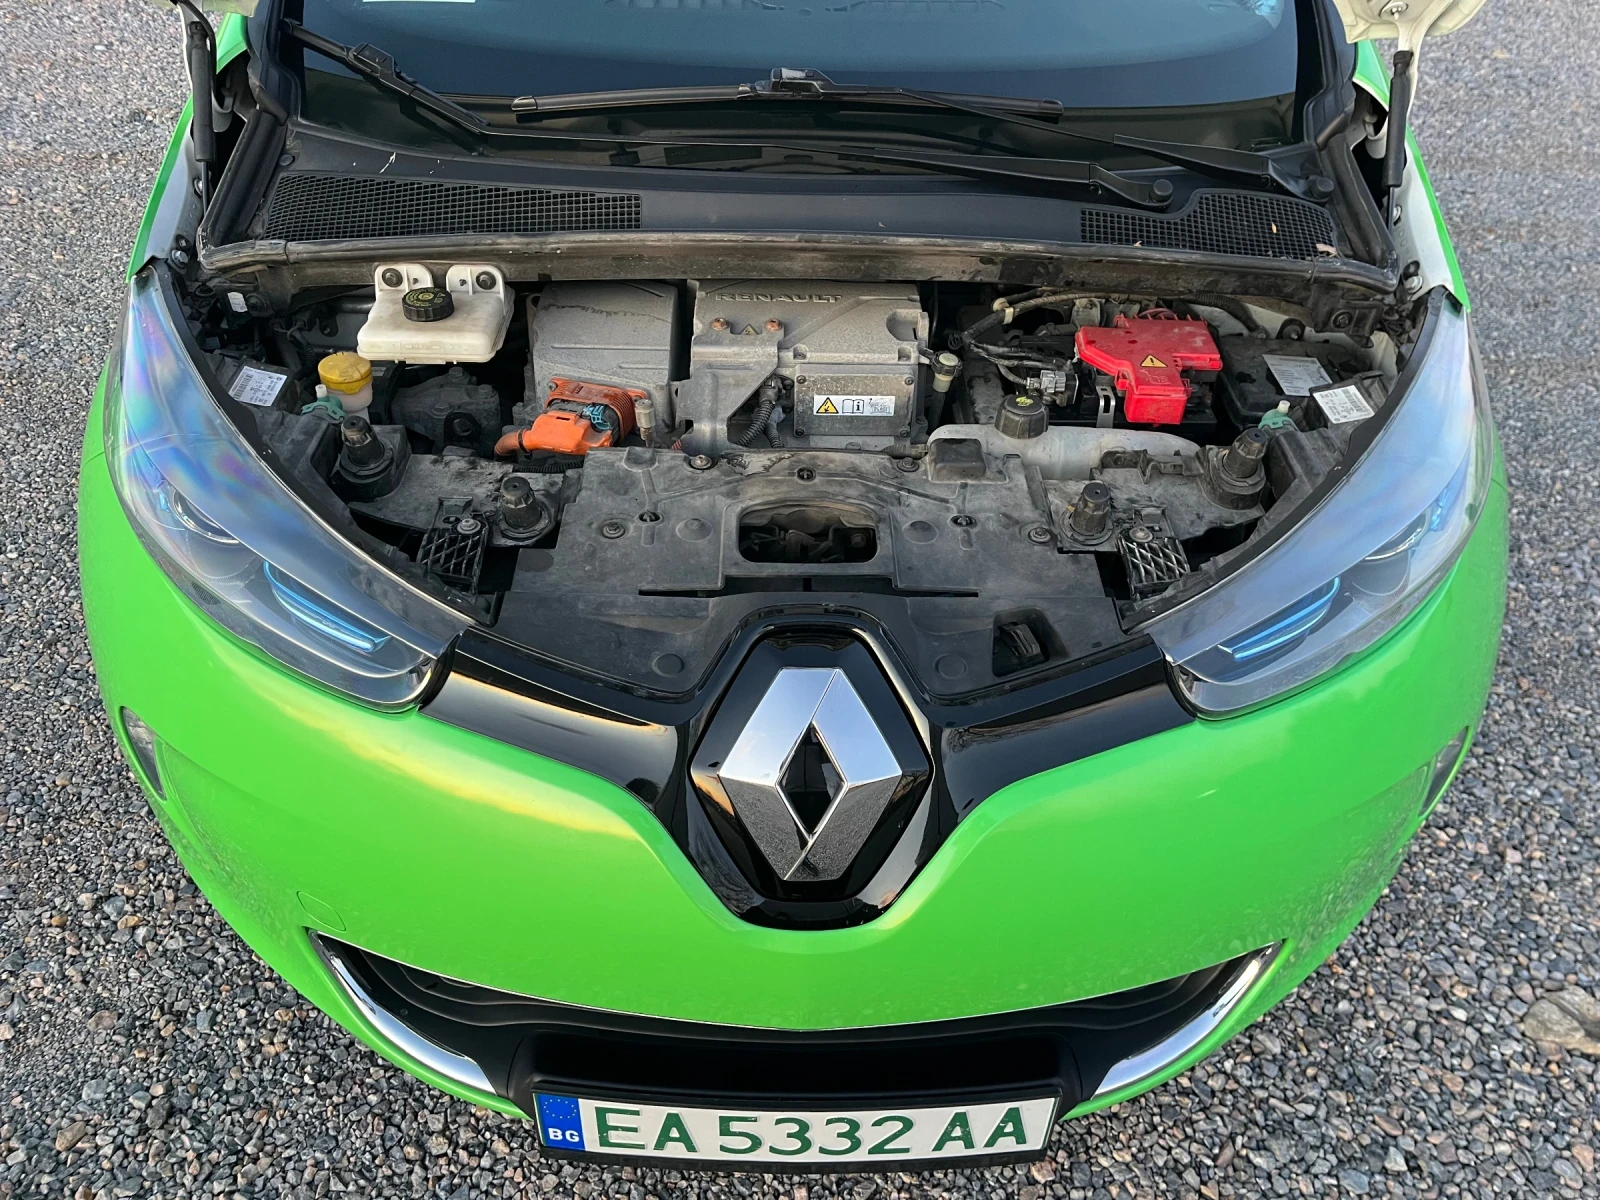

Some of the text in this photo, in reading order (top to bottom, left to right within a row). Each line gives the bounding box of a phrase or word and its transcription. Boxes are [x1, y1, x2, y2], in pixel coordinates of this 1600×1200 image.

[715, 293, 842, 303] RENAULT
[548, 1127, 580, 1143] BG
[594, 1106, 1027, 1156] EA 5332 AA
